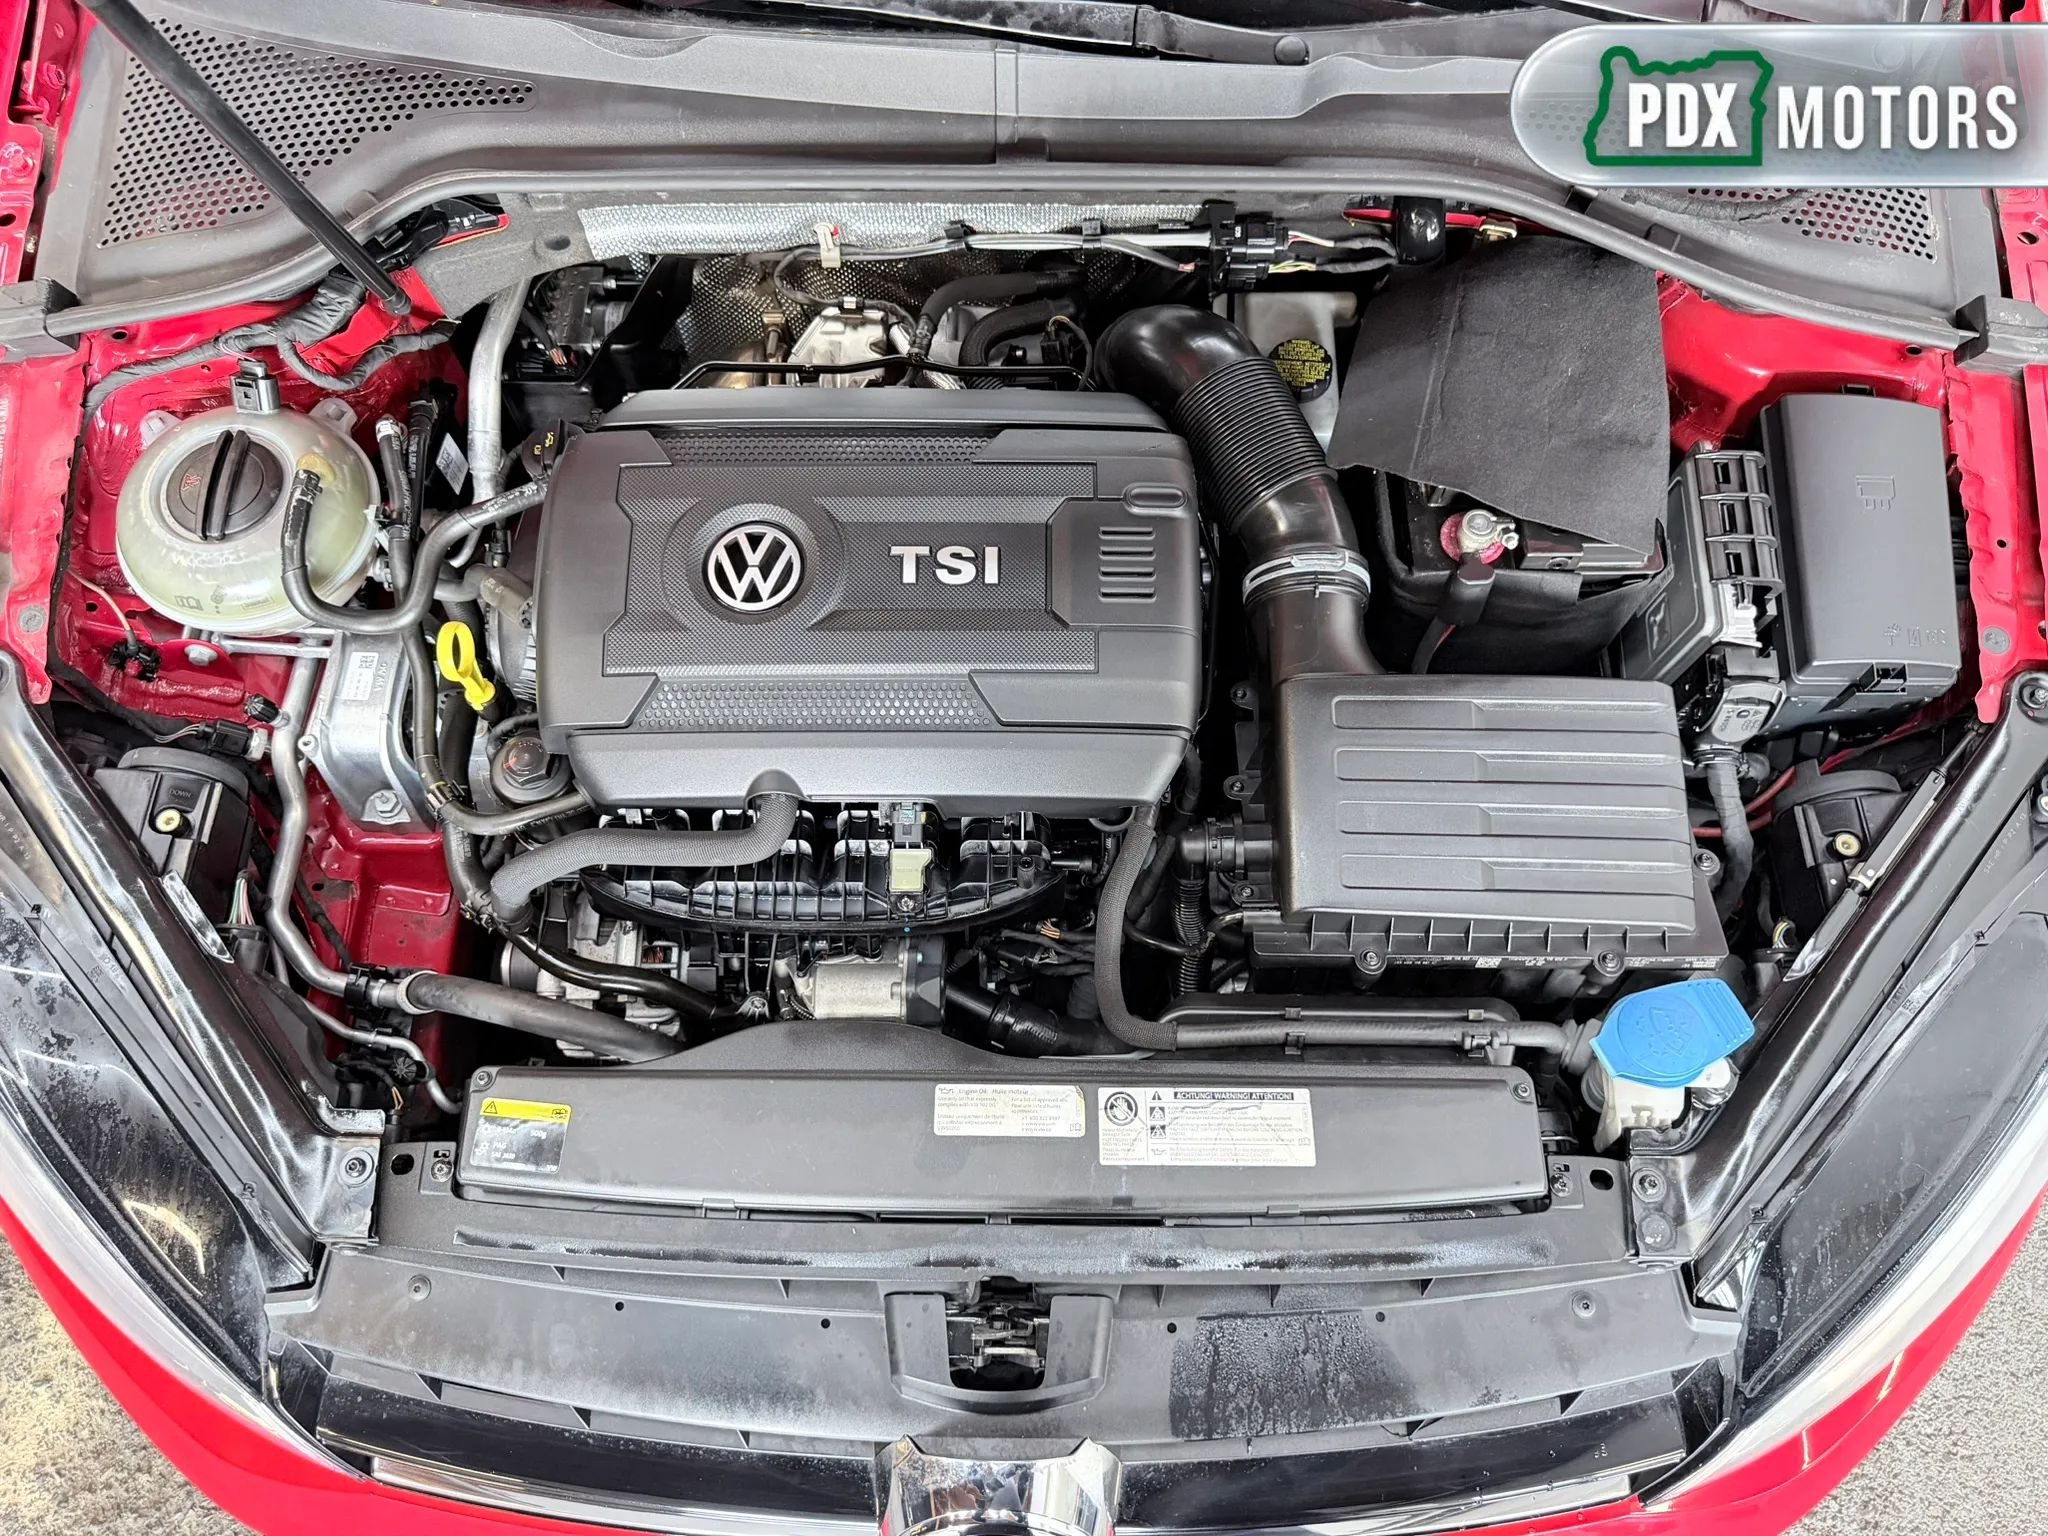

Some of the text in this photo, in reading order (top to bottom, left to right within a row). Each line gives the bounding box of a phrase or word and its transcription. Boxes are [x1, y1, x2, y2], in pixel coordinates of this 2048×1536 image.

[706, 524, 803, 611] VW
[889, 545, 1001, 585] TSI
[169, 788, 192, 798] DOWN
[958, 1088, 978, 1096] Engine
[1176, 1091, 1294, 1101] ACHTUNG! WARNING! ATTENTION!
